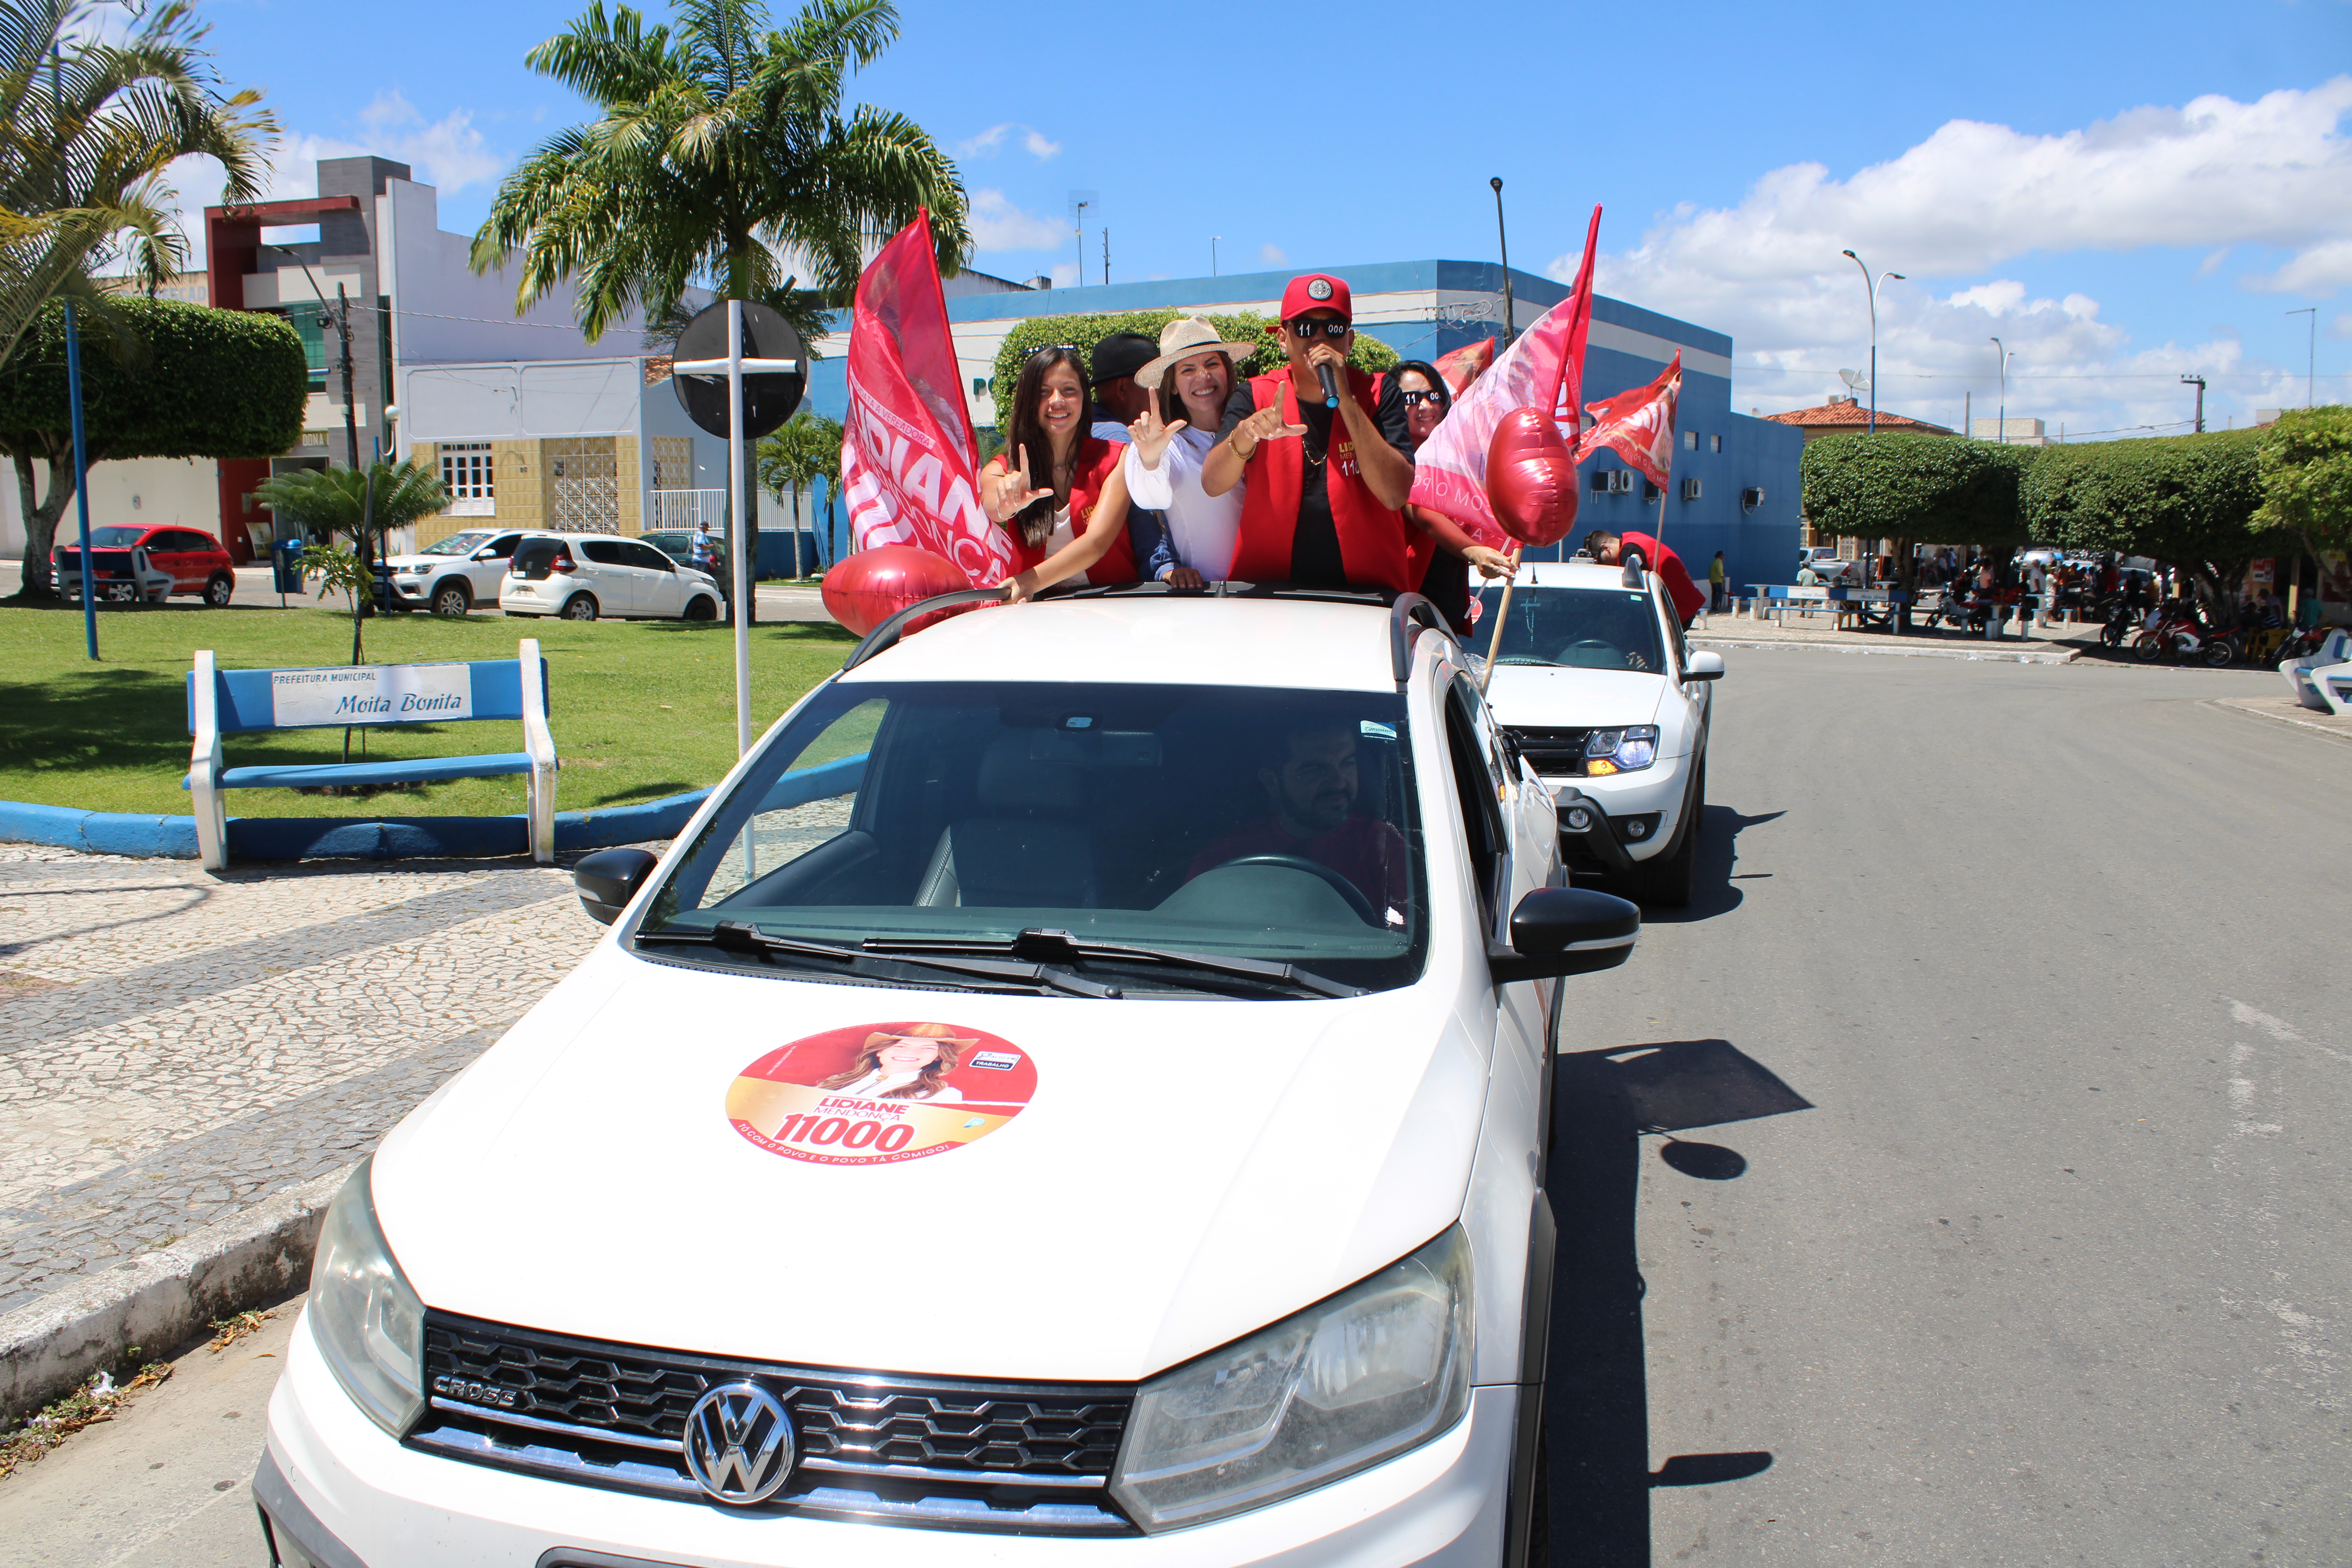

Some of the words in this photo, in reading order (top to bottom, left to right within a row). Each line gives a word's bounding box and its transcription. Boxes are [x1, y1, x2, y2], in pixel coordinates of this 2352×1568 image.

[1299, 324, 1310, 336] 11
[1328, 325, 1343, 333] 000
[1406, 393, 1416, 404] 11
[883, 409, 930, 447] VEREADORA
[302, 433, 324, 446] DONA
[274, 673, 328, 685] PREFEITURA
[331, 672, 376, 682] MUNICIPAL
[335, 695, 390, 715] Moita
[400, 693, 462, 711] Bonita
[818, 1098, 910, 1114] LIDIANE
[813, 1107, 900, 1122] MENDONÇA
[773, 1113, 915, 1152] 11000
[747, 1131, 768, 1145] COM
[777, 1146, 807, 1158] POVO
[891, 1144, 949, 1161] COMIGO!
[434, 1375, 517, 1406] CROSS
